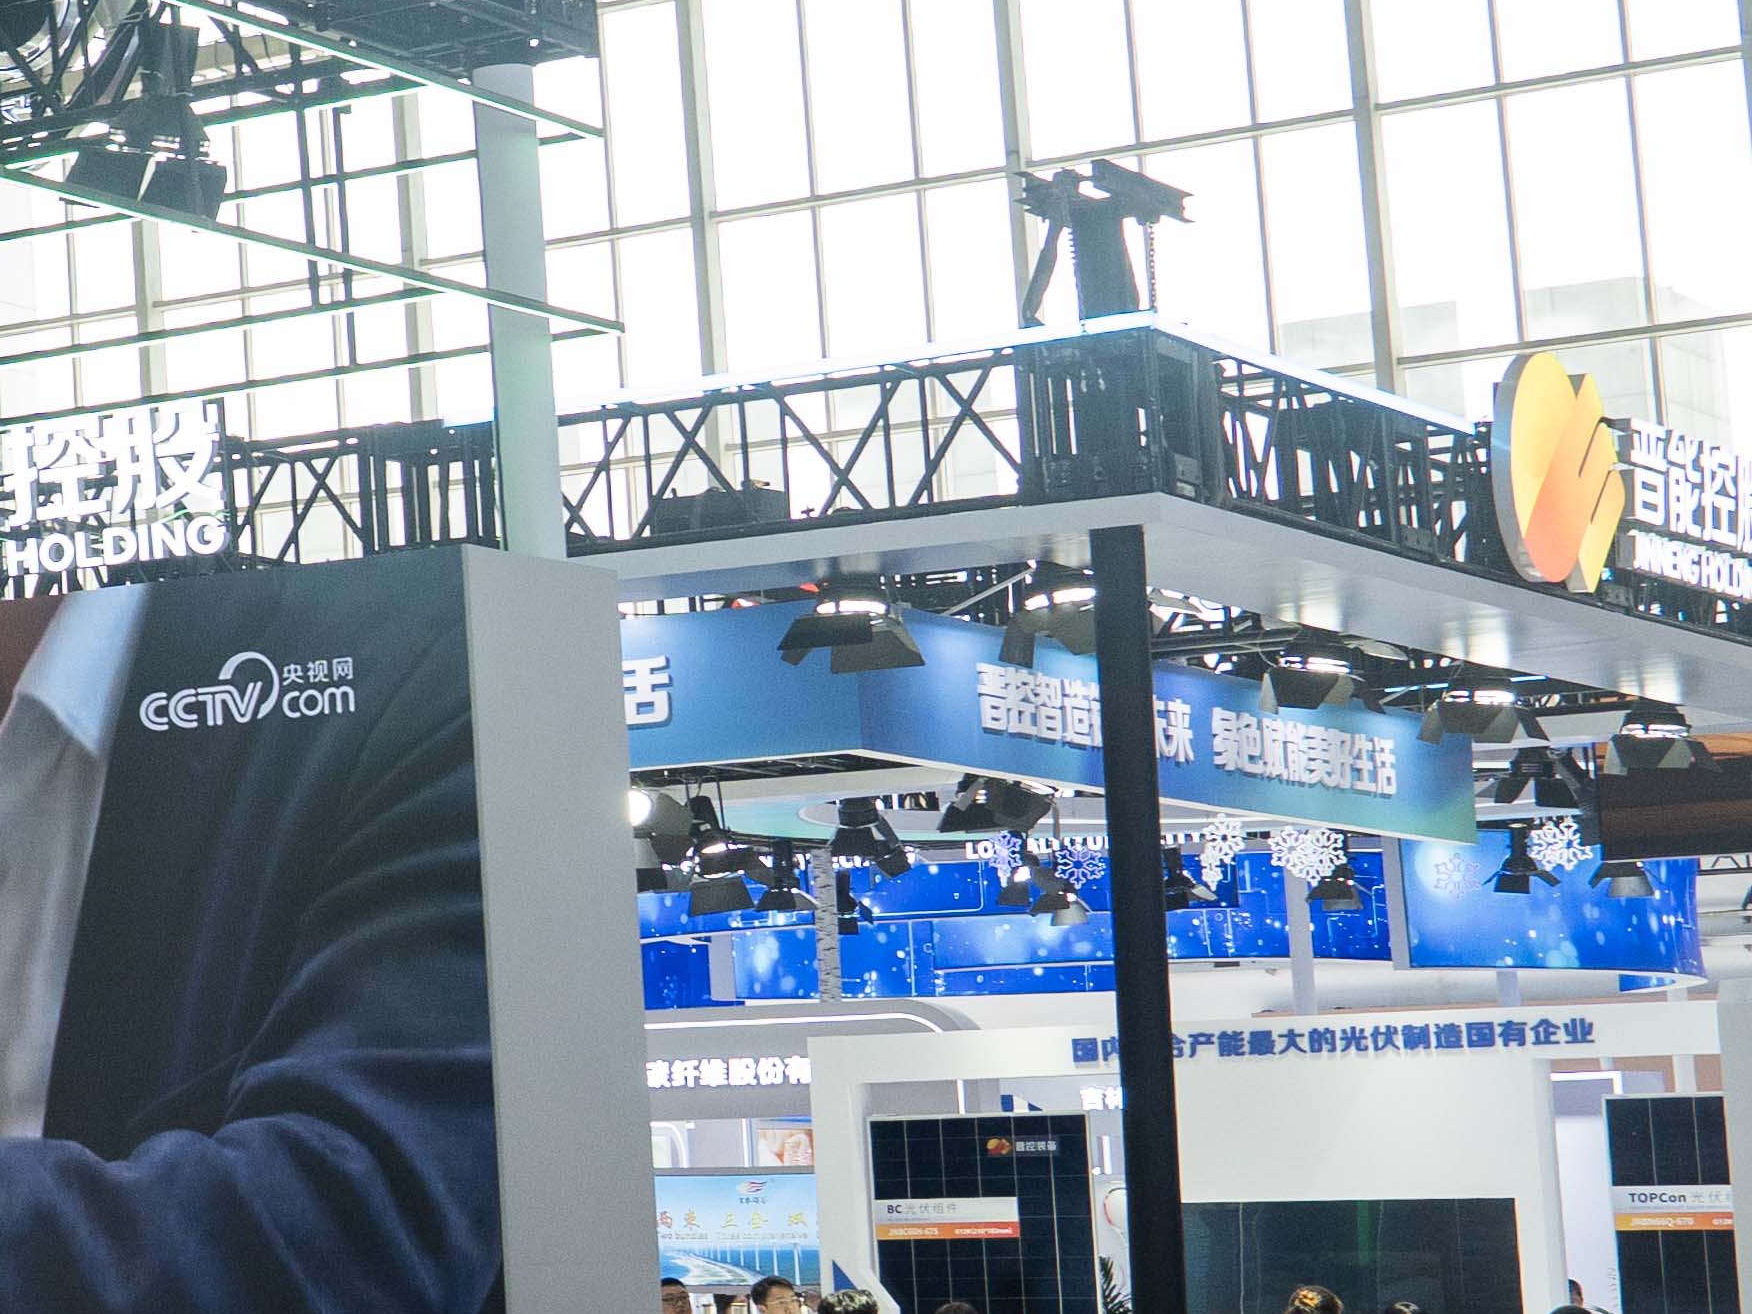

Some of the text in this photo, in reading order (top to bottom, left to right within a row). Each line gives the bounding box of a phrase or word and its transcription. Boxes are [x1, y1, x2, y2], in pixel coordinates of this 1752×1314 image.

[6, 512, 231, 578] HOLDING
[282, 657, 353, 685] 央视网
[139, 681, 263, 731] CCTV
[282, 686, 355, 718] com
[1211, 707, 1397, 796] 绿色赋能美好生活
[887, 1204, 902, 1214] BC
[1628, 1193, 1686, 1203] TOPCon
